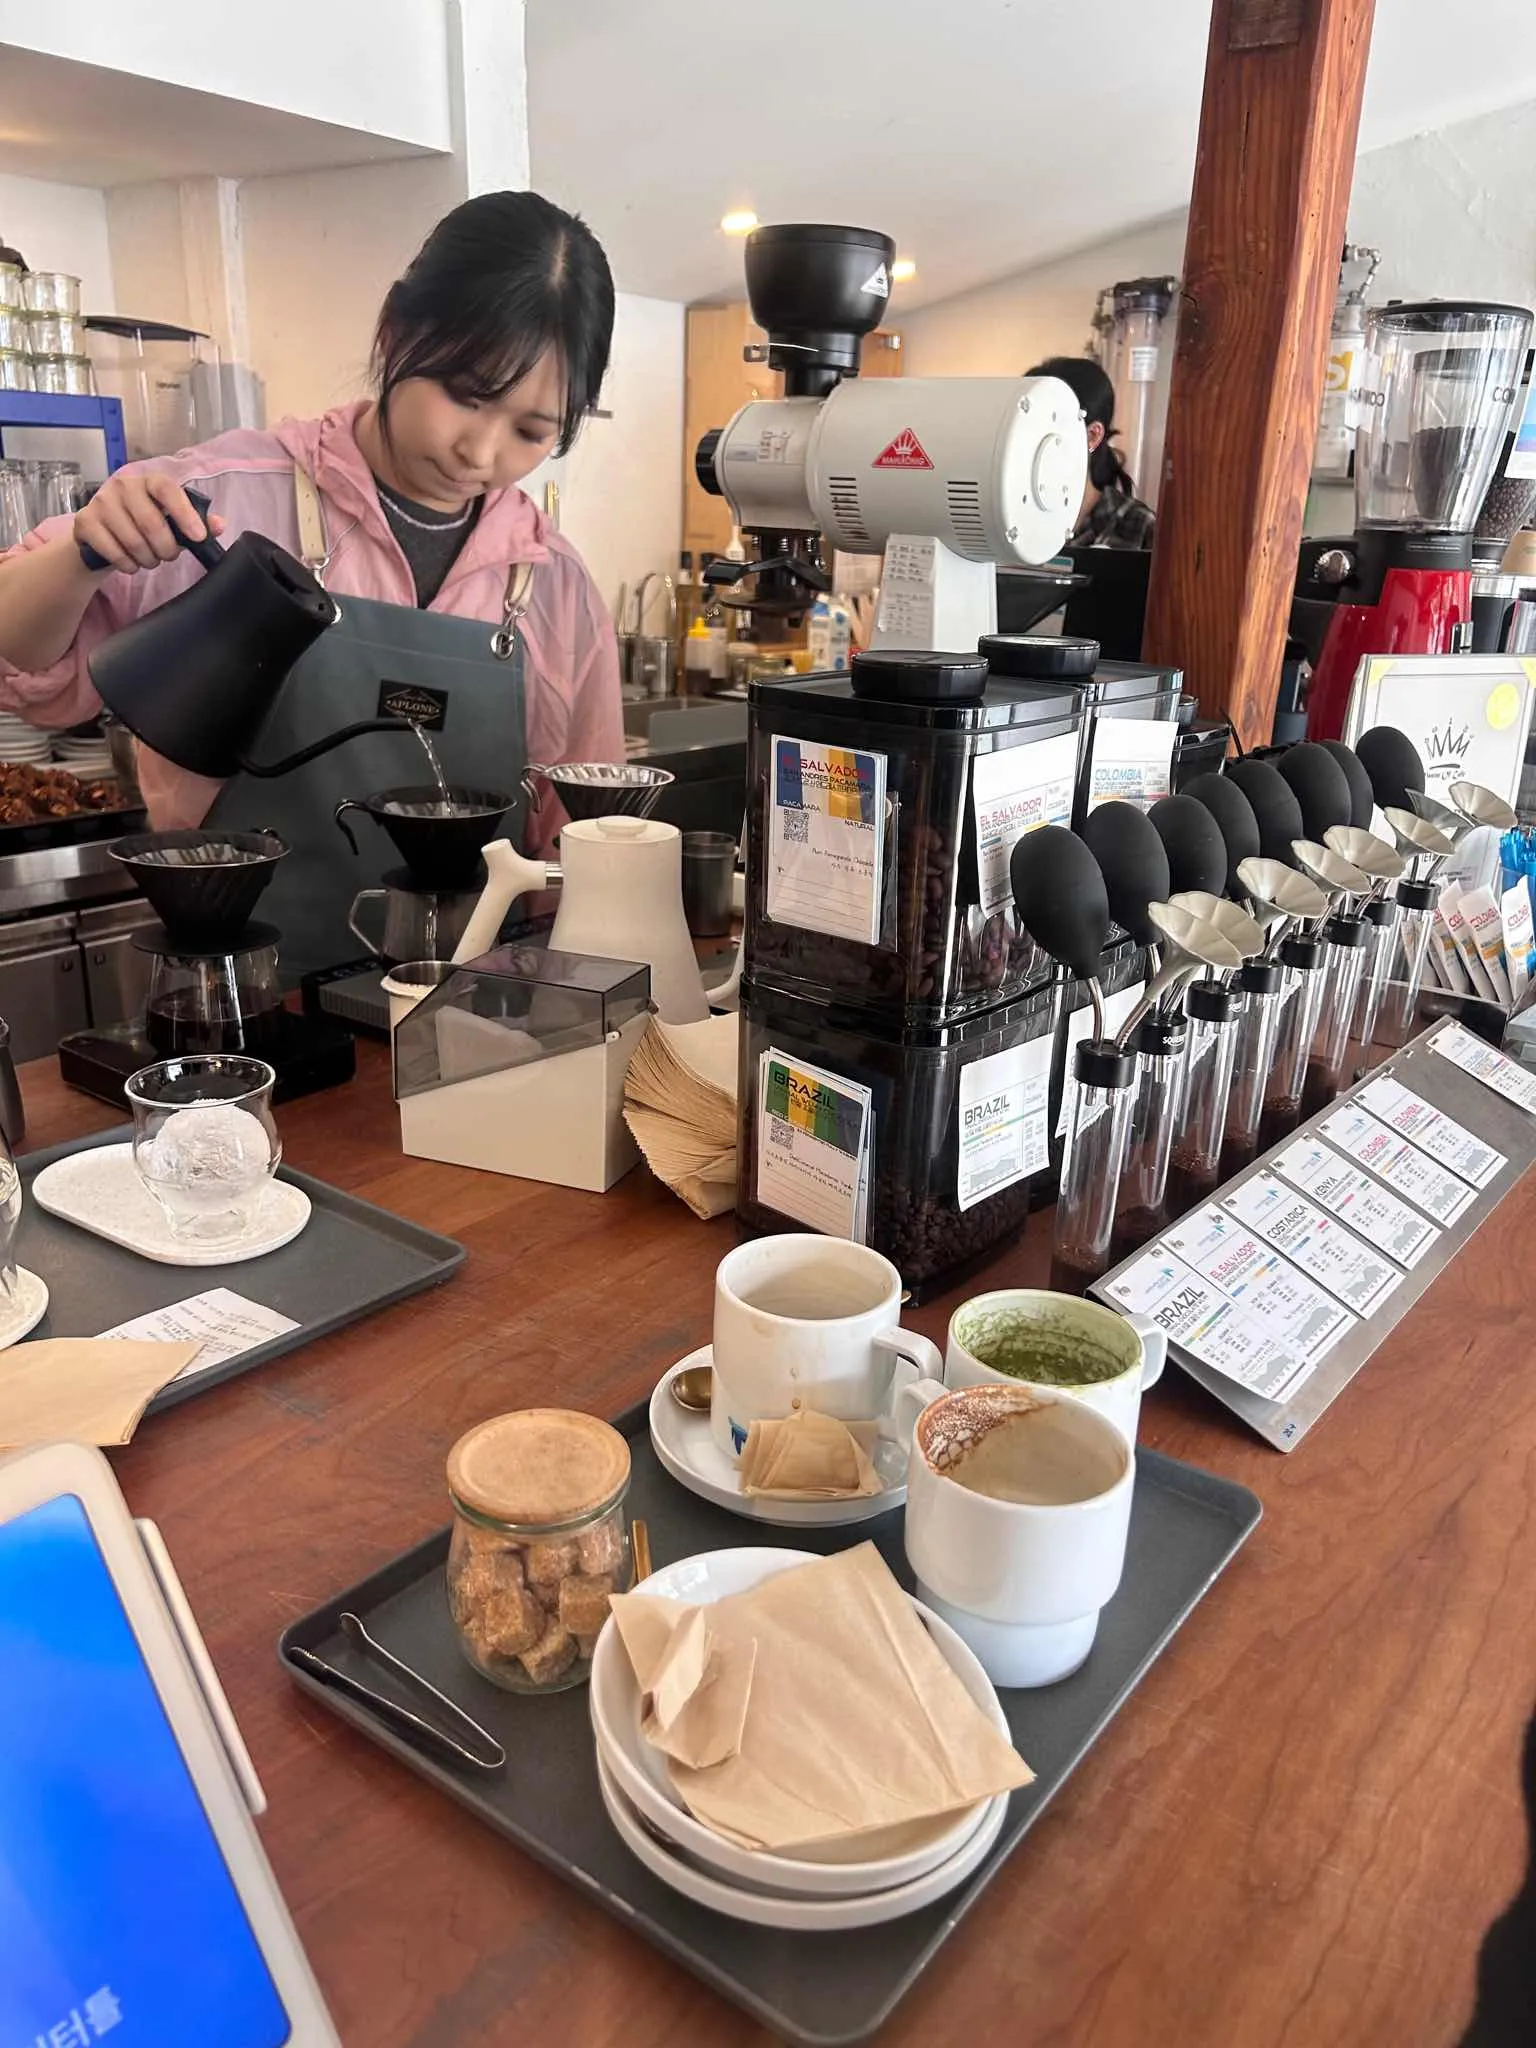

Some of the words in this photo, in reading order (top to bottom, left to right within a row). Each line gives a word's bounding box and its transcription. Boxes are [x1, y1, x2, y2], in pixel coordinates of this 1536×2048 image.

[1094, 768, 1143, 781] COLOMBIA
[991, 798, 1042, 821] SALVADOR
[774, 1070, 835, 1111] BRAZIL
[964, 1094, 1010, 1126] BRAZIL
[1312, 1175, 1339, 1197] KENYA
[1209, 1268, 1222, 1279] EL
[1219, 1241, 1256, 1272] SALVADOR
[1152, 1283, 1205, 1328] BRAZIL
